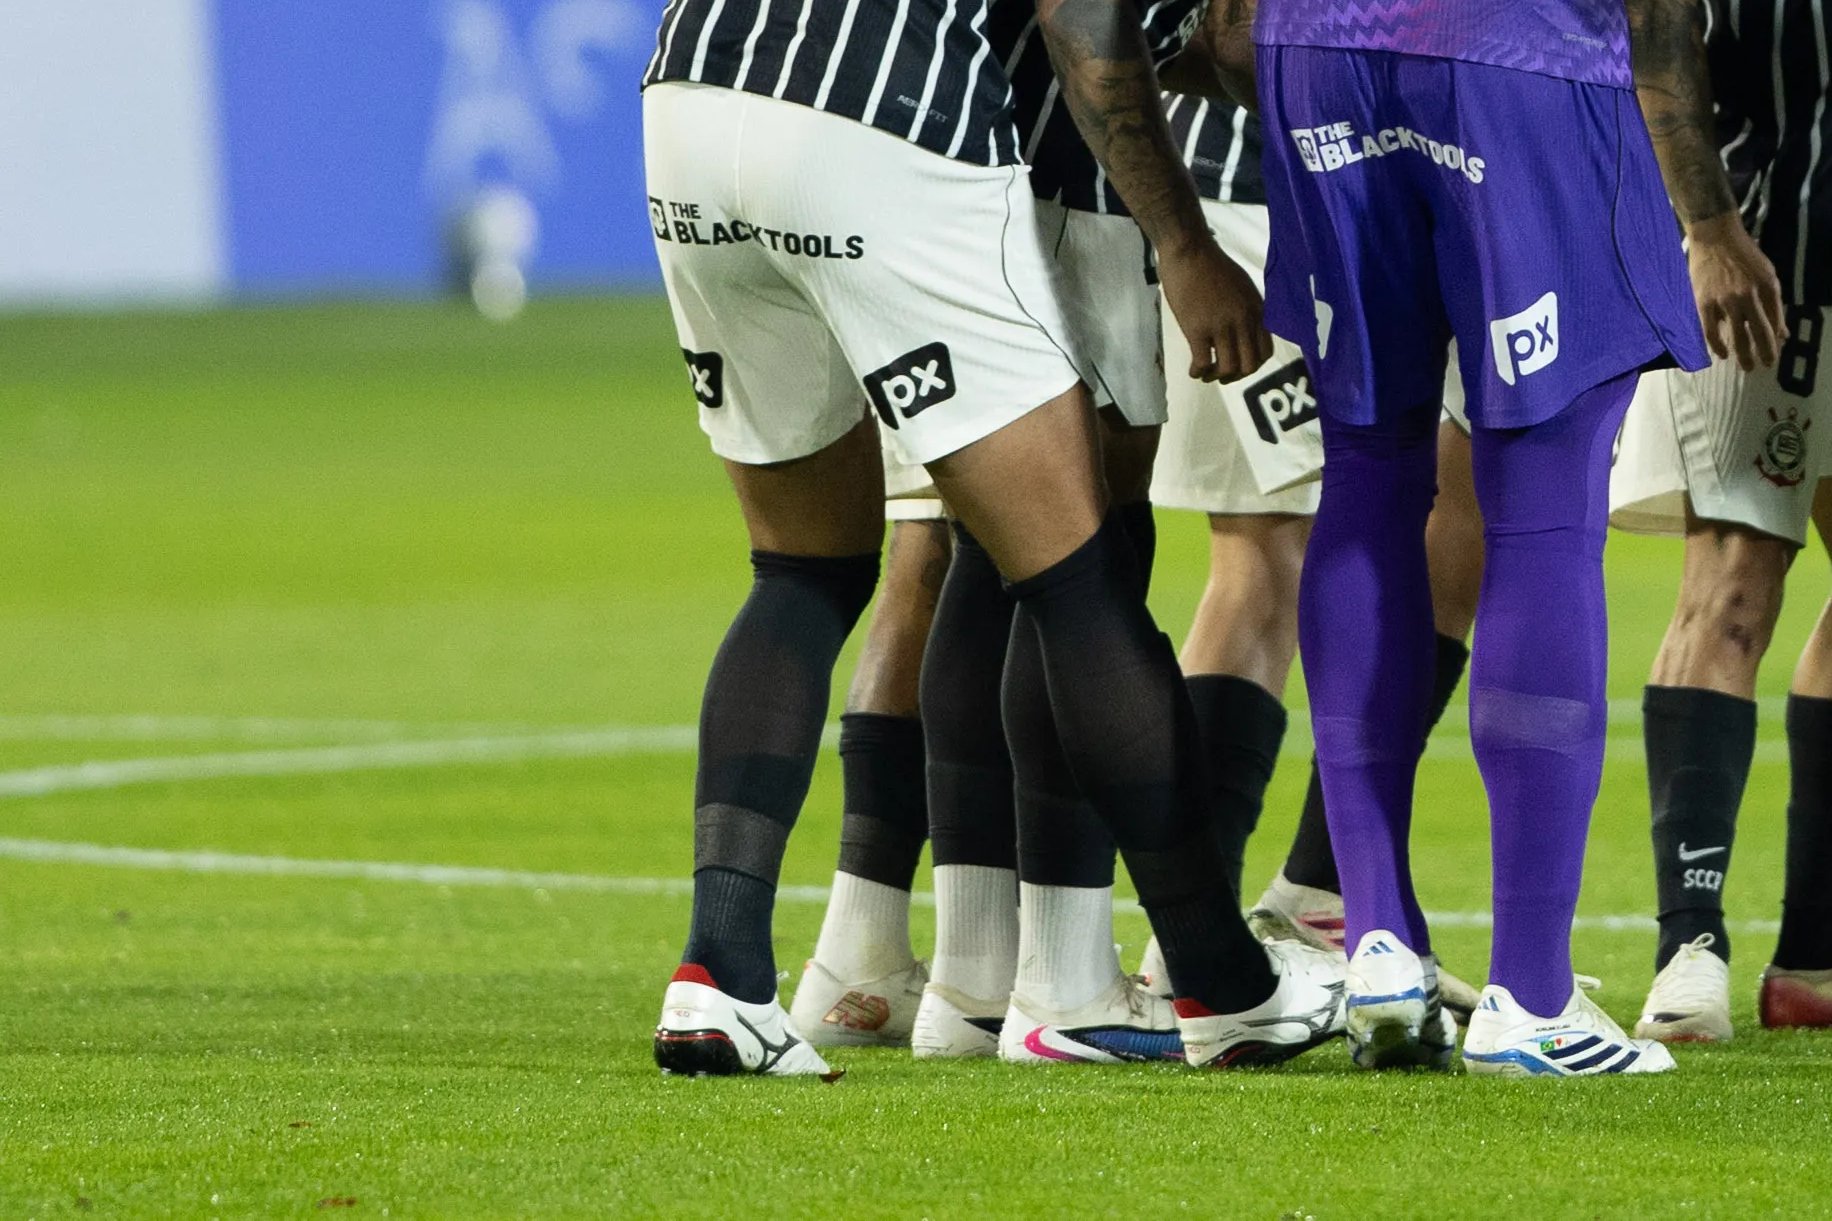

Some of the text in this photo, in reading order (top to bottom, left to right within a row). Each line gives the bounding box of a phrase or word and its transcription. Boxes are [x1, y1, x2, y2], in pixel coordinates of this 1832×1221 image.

[1313, 120, 1356, 144] THE
[1320, 125, 1486, 184] BLACKTOOLS
[668, 201, 702, 220] THE
[672, 219, 865, 260] BLACKTOOLS
[1506, 314, 1554, 385] px
[1777, 302, 1825, 399] 8
[880, 358, 947, 429] px
[1258, 375, 1318, 439] px
